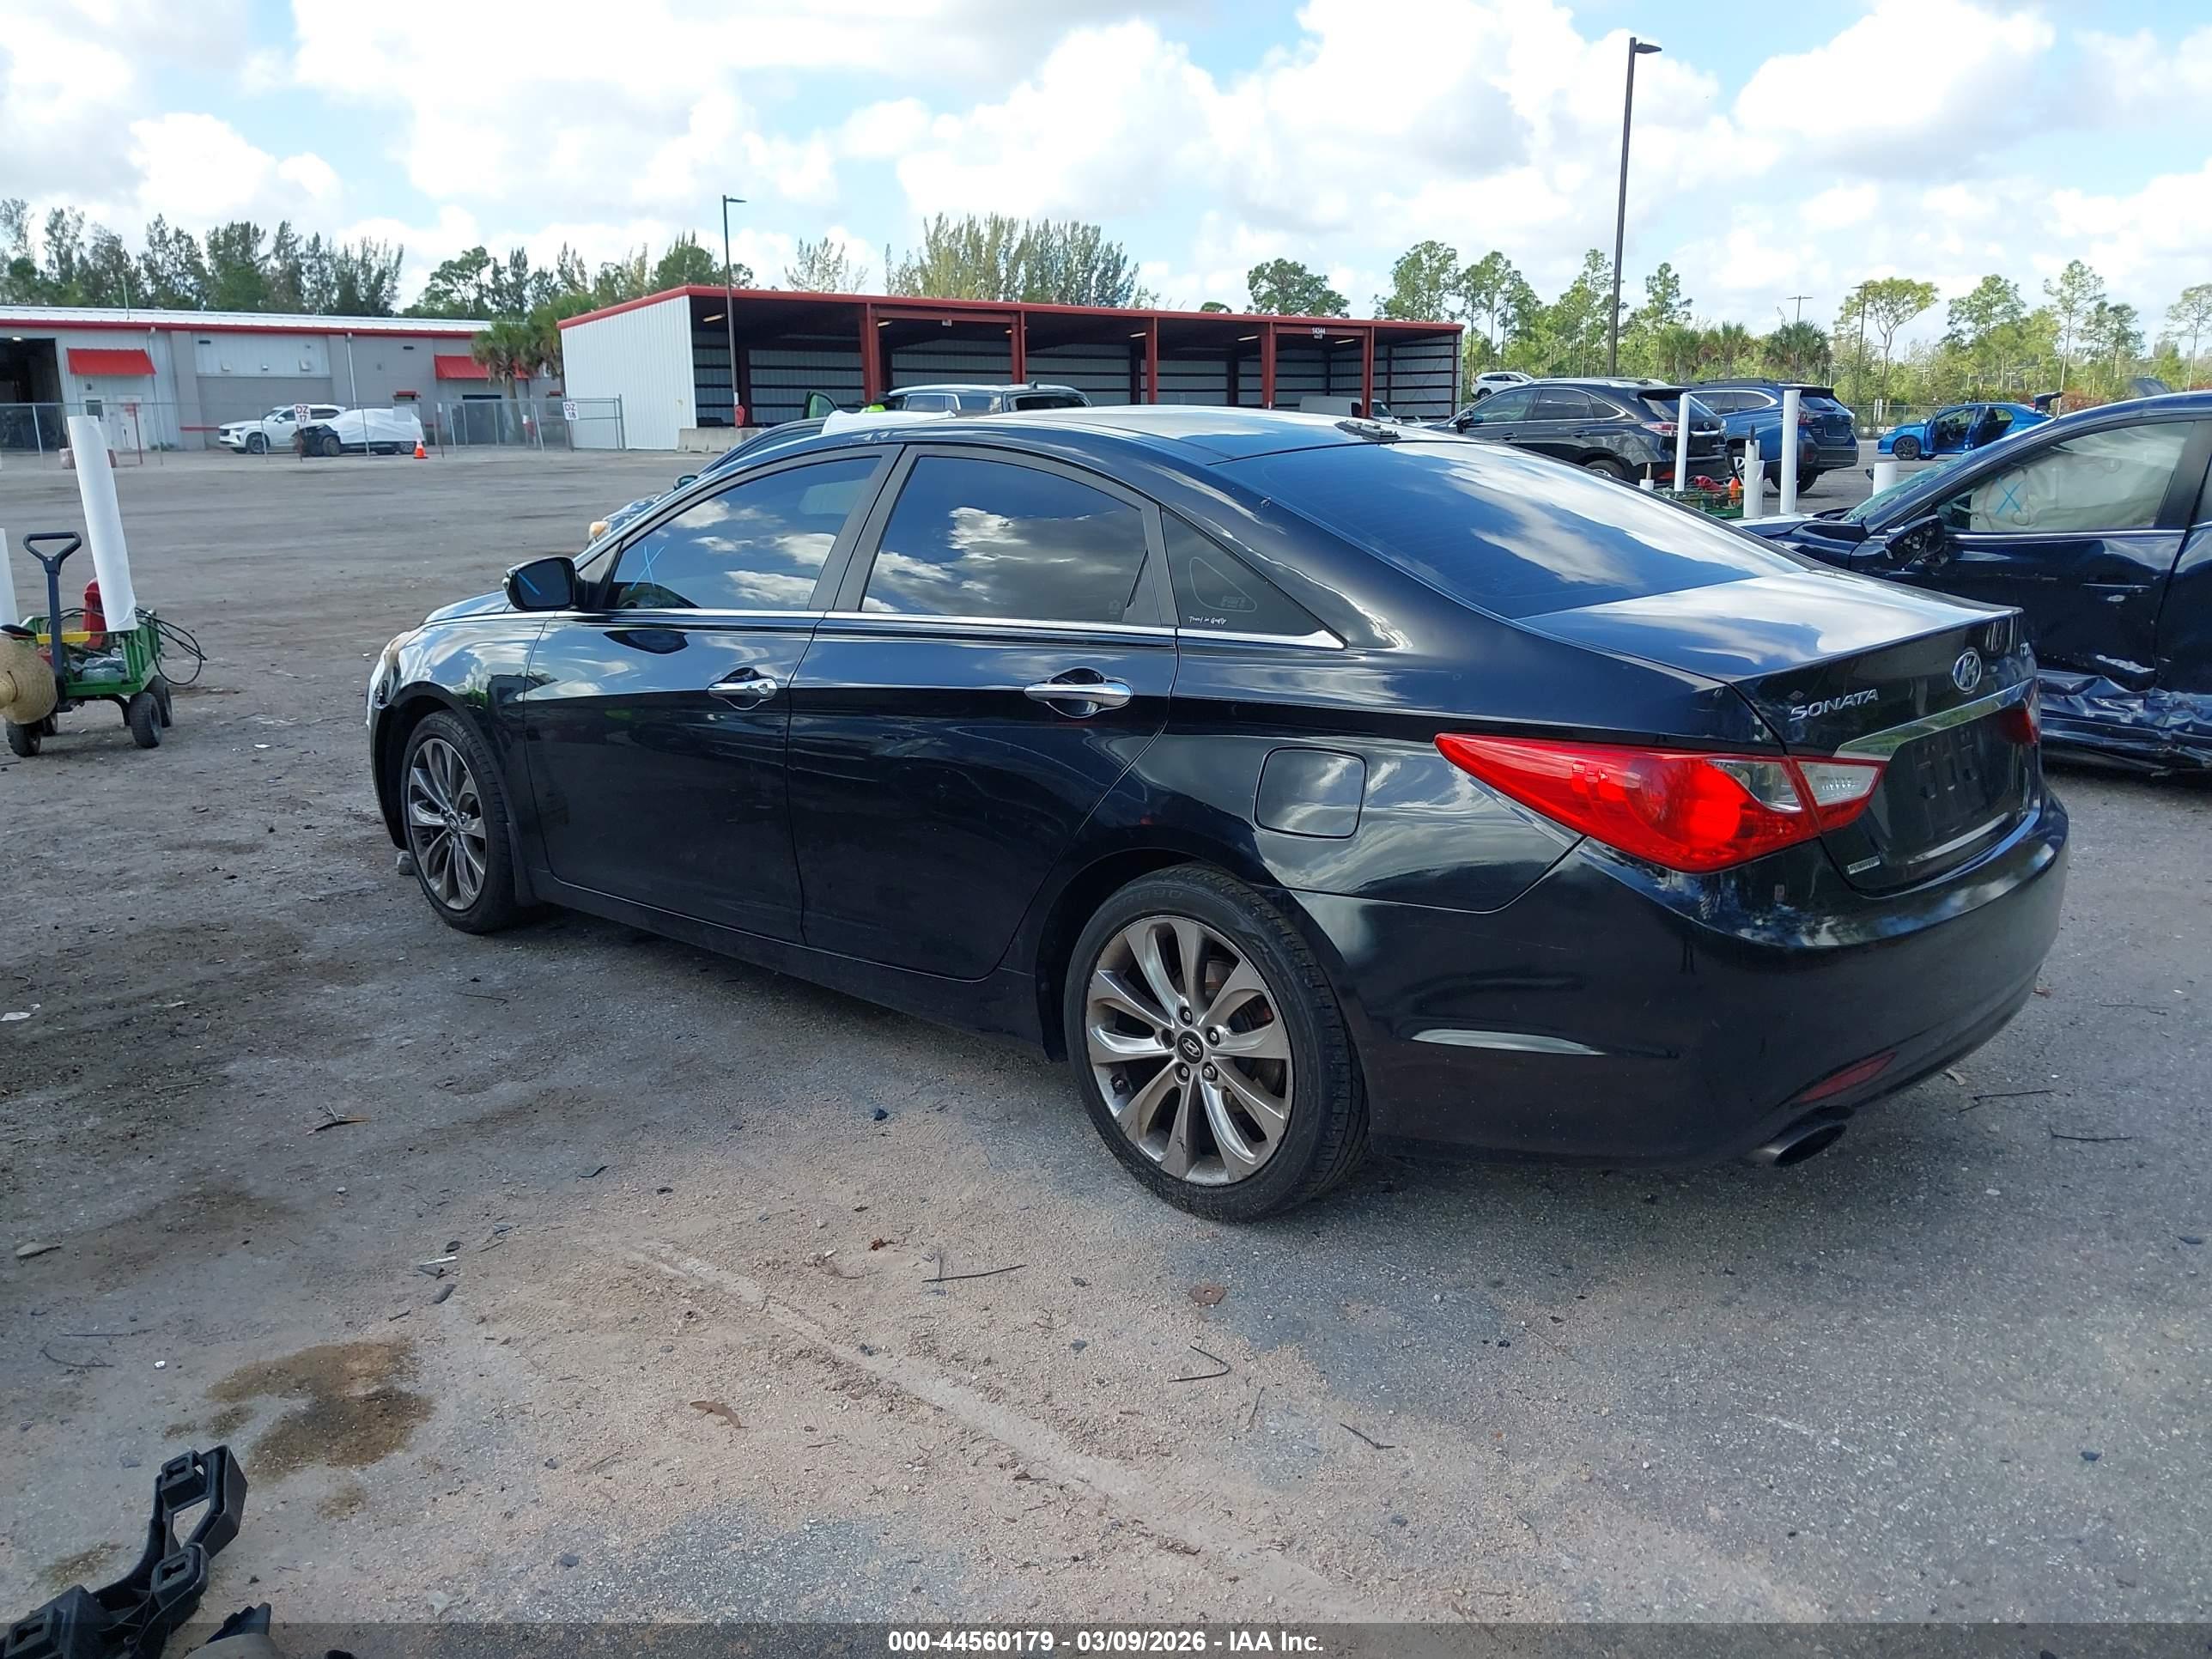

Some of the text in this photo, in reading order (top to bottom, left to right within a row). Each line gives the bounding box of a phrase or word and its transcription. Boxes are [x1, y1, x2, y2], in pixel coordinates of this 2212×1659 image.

[295, 404, 309, 414] DZ
[300, 414, 307, 422] 17
[1788, 689, 1879, 721] SONATA
